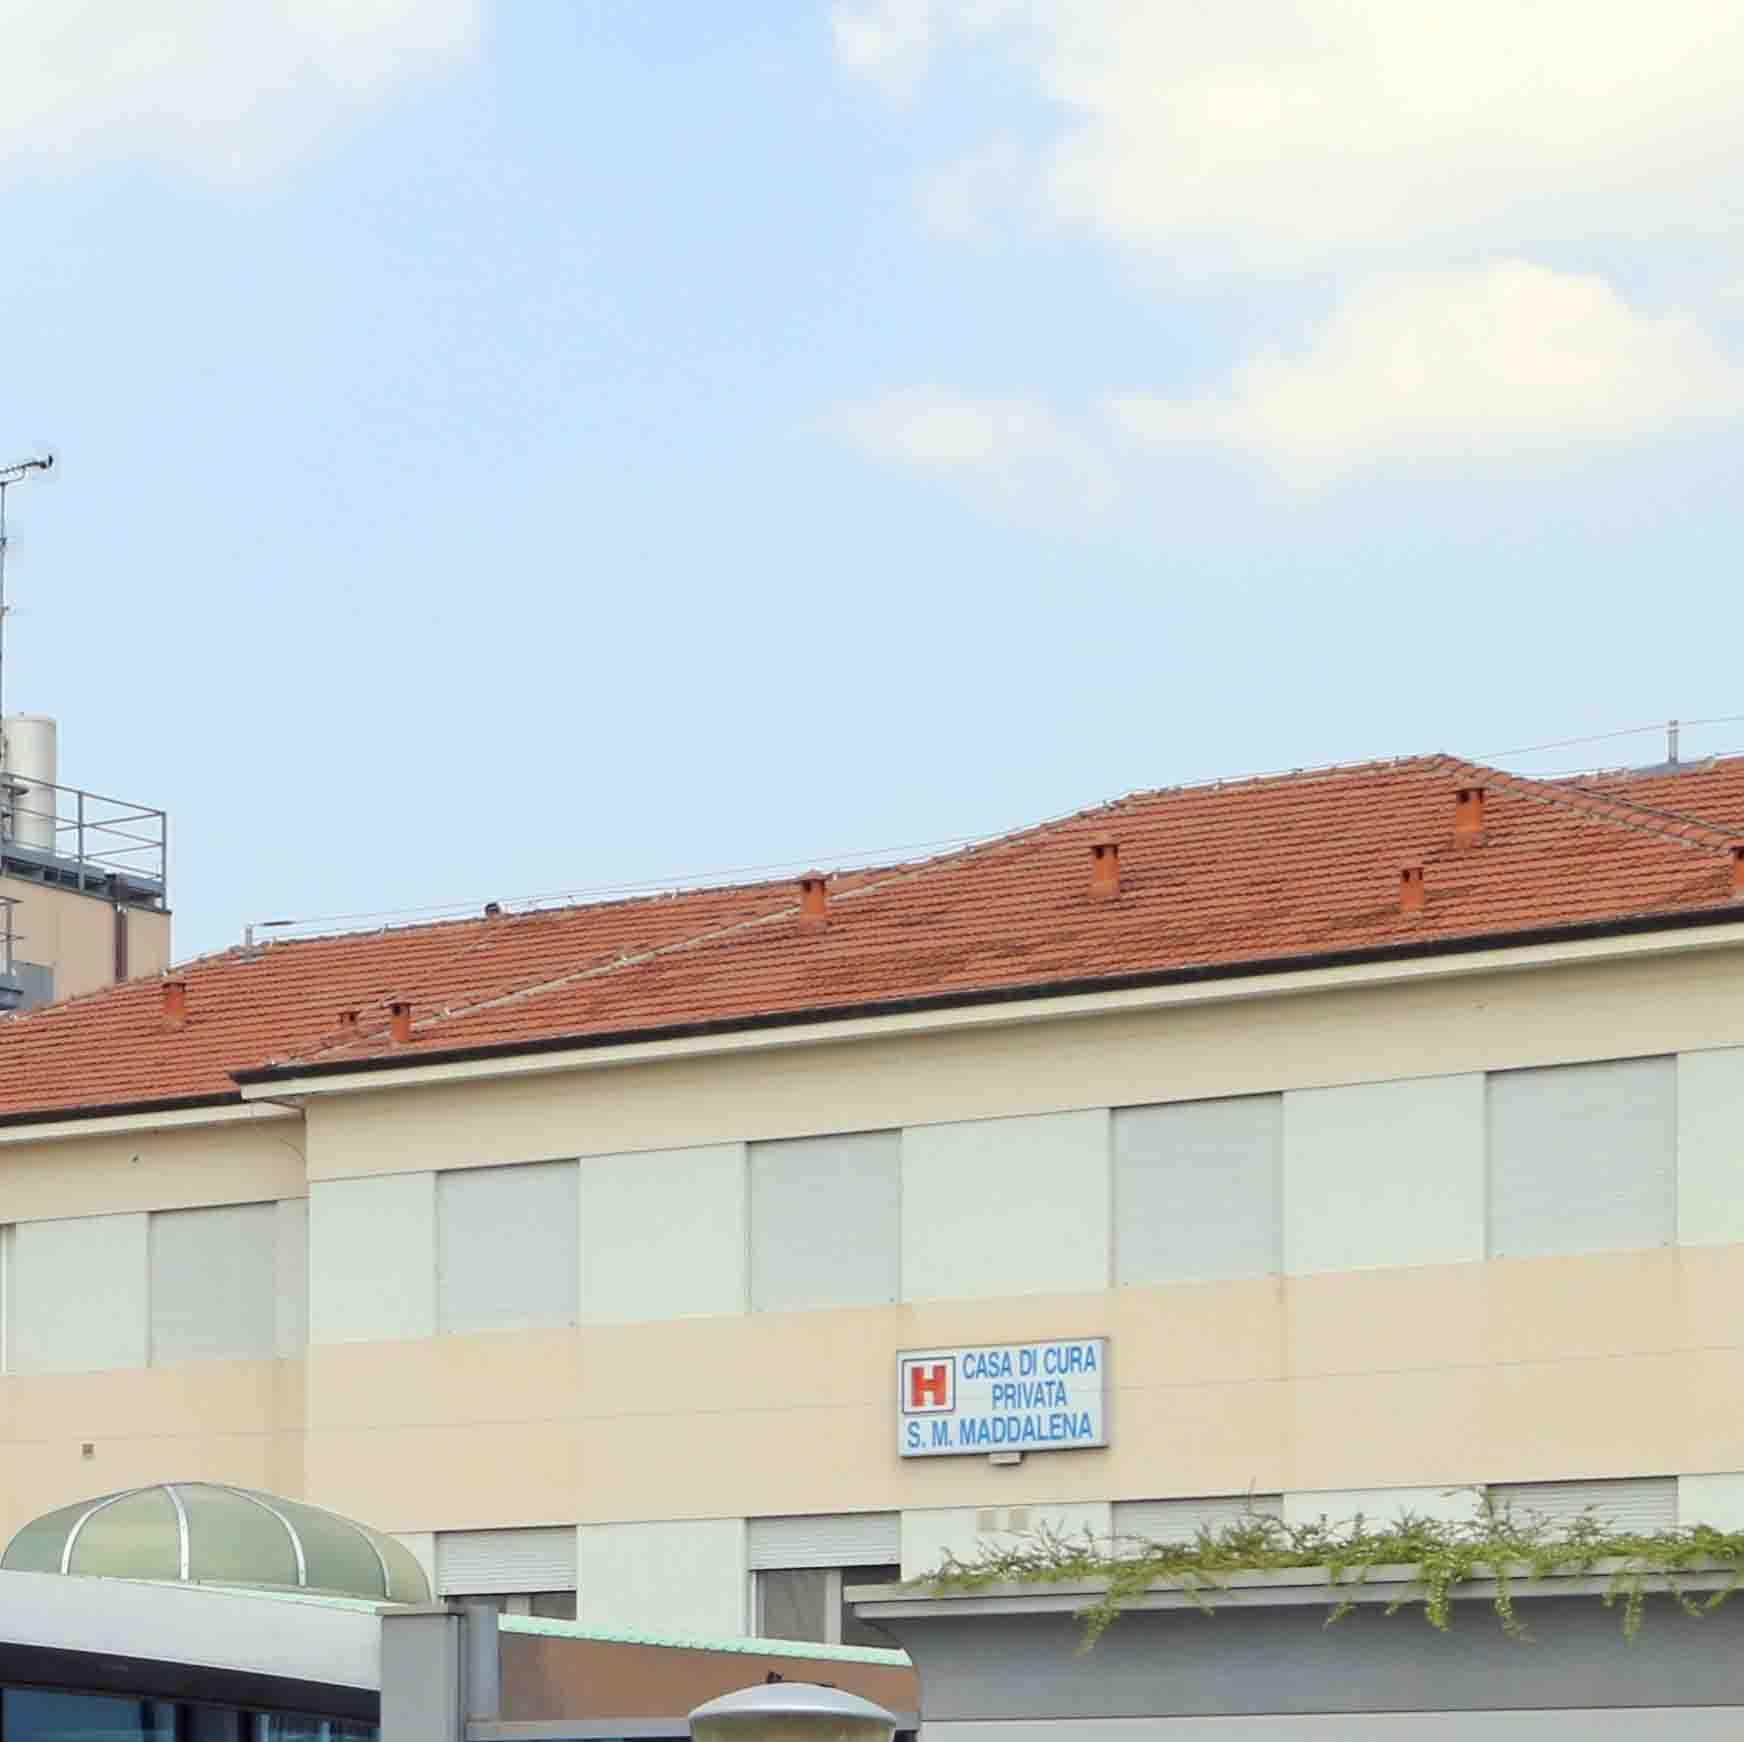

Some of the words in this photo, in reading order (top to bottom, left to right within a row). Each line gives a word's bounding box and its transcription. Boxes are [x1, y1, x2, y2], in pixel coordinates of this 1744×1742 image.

[962, 1351, 1012, 1379] CASA
[1019, 1349, 1038, 1376] DI
[1043, 1346, 1097, 1374] CURA
[910, 1364, 946, 1407] H
[992, 1381, 1068, 1410] PRIVATA
[907, 1421, 927, 1449] S.
[932, 1420, 953, 1448] M.
[959, 1413, 1094, 1445] MADDALENA
